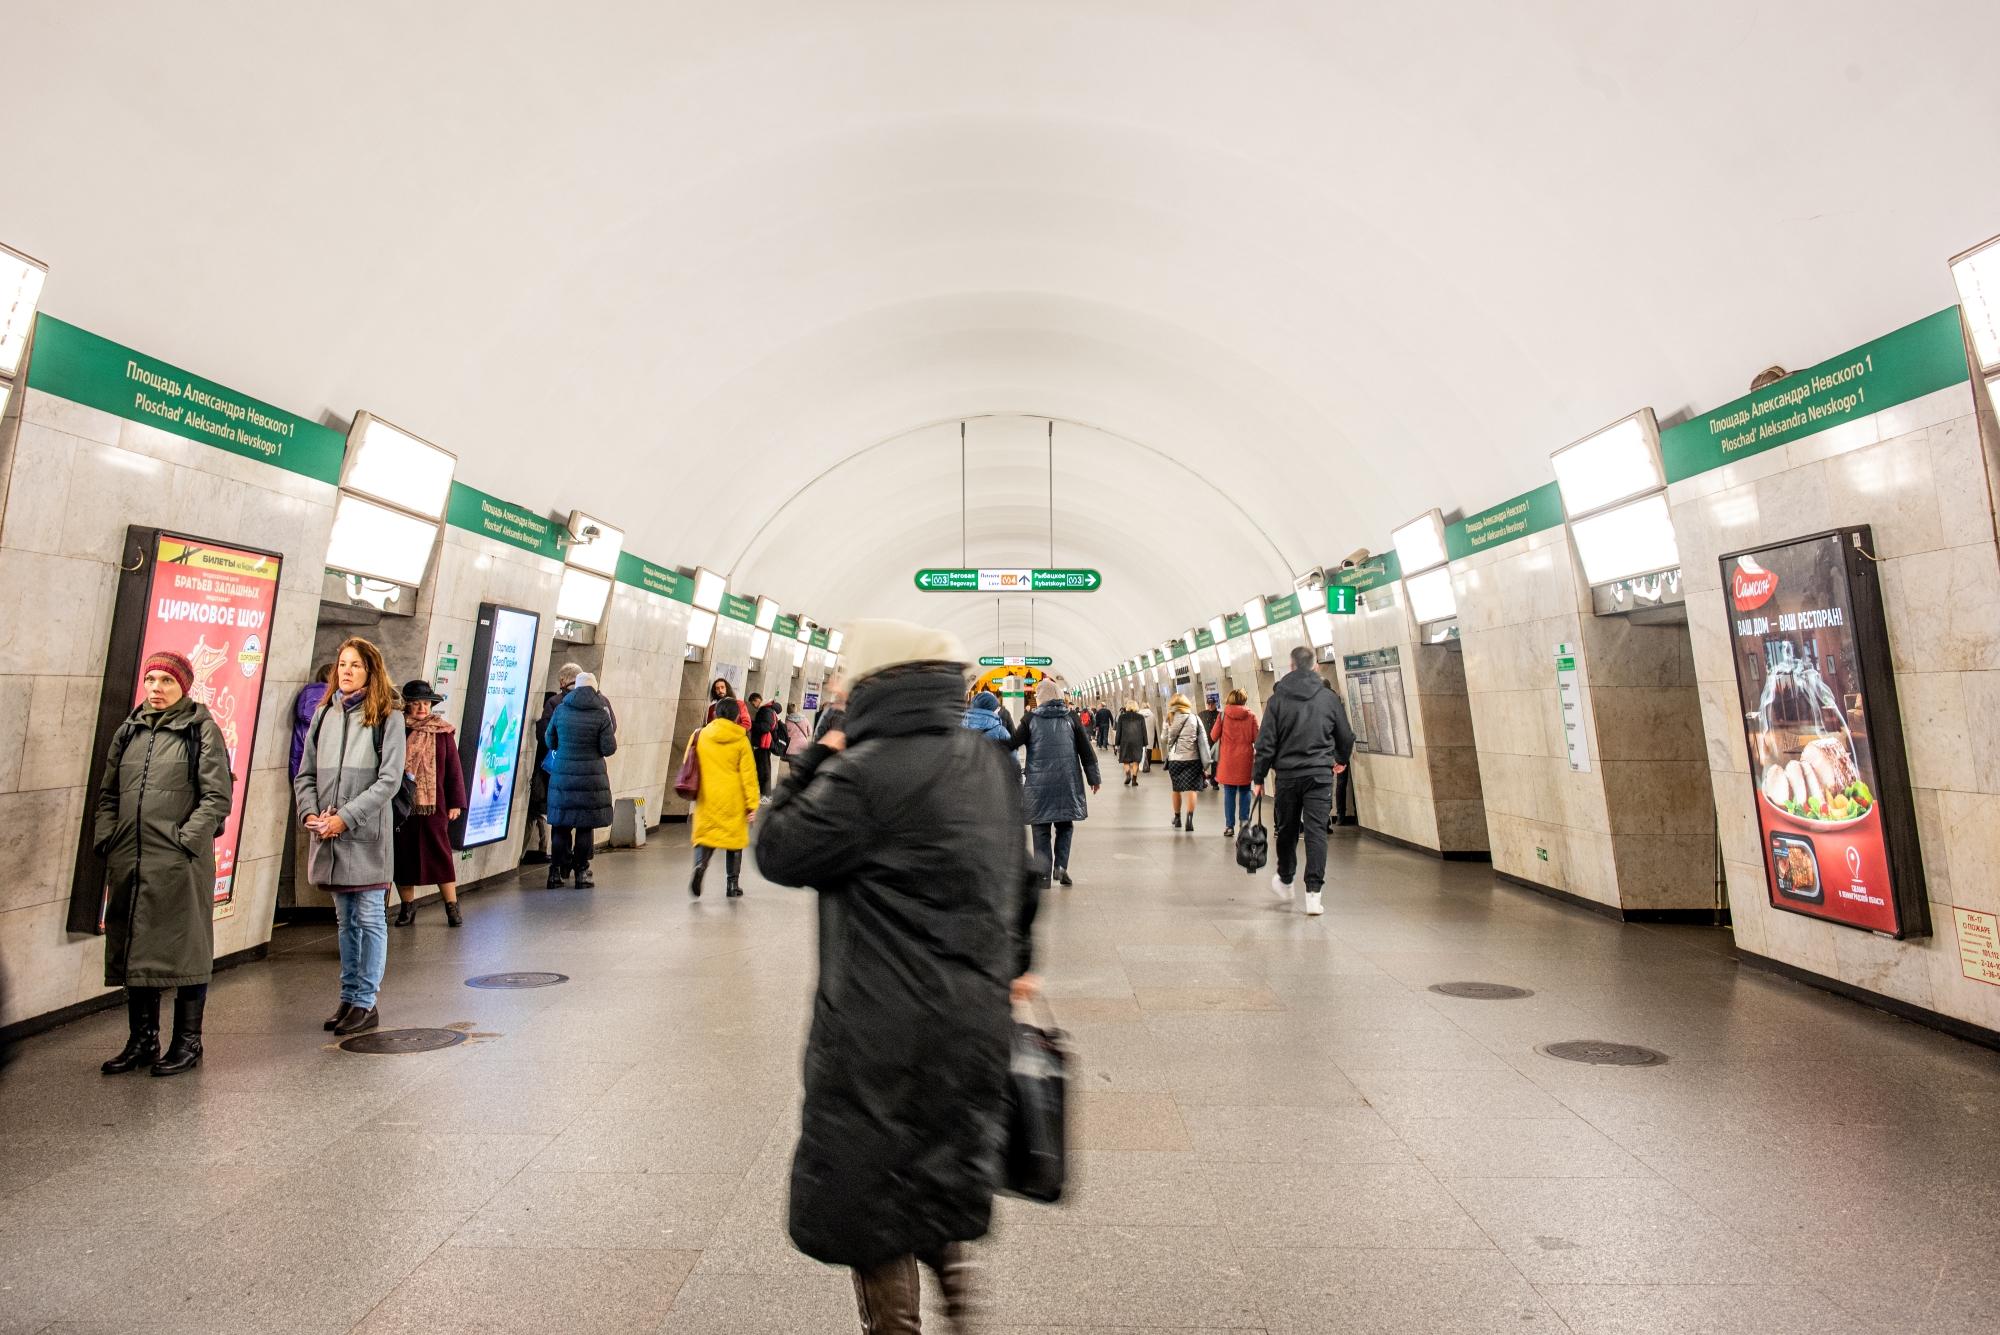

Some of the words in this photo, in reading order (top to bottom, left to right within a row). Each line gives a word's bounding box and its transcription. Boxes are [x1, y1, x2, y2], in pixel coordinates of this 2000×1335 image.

[126, 360, 181, 397] Площадь
[183, 384, 245, 420] Александра
[247, 407, 288, 435] Невского
[290, 423, 294, 437] 1
[1710, 410, 1750, 434] Площадь
[1751, 384, 1810, 419] Александра
[1812, 362, 1864, 394] Невского
[1866, 354, 1873, 372] 1
[135, 392, 184, 422] Ploschad'
[184, 411, 235, 440] Aleksandra
[237, 428, 276, 456] Nevskogo
[277, 443, 282, 456] 1
[1721, 428, 1757, 453] Ploschad'
[1760, 411, 1808, 440] Aleksandra
[1808, 392, 1856, 421] Nevskogo
[1858, 387, 1865, 403] 1
[203, 555, 236, 568] БИЛЕТЫ
[174, 575, 213, 592] БРАТЬЕВ
[214, 581, 260, 599] ЗАПАШНЫХ
[1735, 575, 1769, 598] Самсон
[157, 598, 235, 626] ЦИРКОВОЕ
[237, 609, 266, 628] ШОУ
[1737, 620, 1752, 636] ВАШ
[1754, 617, 1769, 636] ДОМ
[1778, 613, 1796, 632] ВАШ
[1799, 607, 1843, 630] РЕСТОРАН!
[1968, 924, 1990, 934] ПОЖАРЕ
